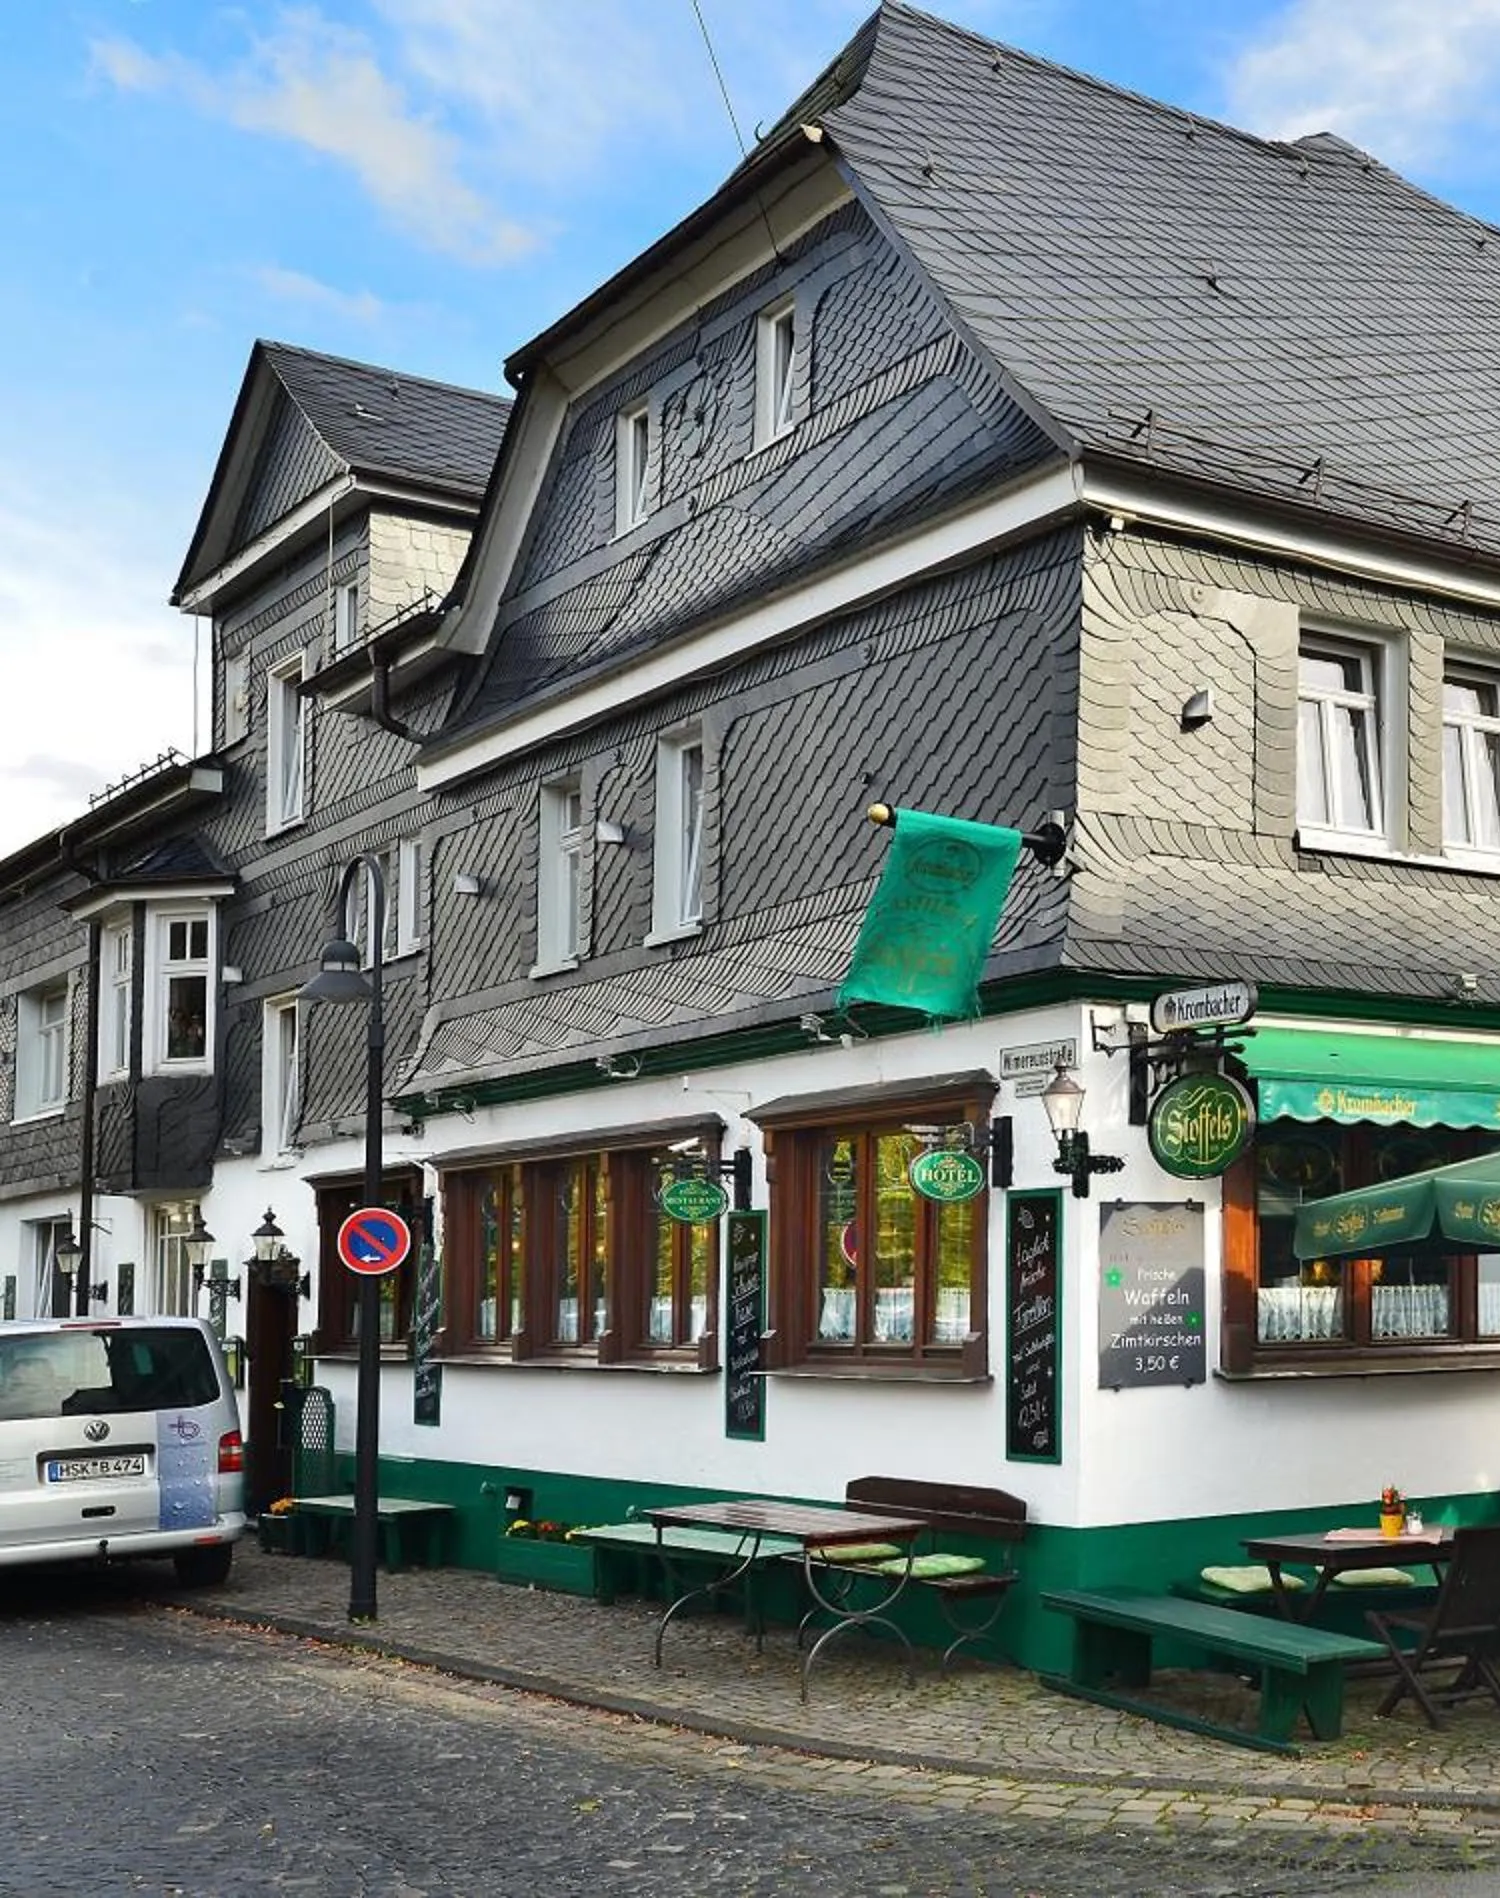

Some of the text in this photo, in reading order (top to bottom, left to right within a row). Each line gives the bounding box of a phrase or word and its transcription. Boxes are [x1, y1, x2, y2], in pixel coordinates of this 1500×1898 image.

[1177, 990, 1241, 1022] Krombacher
[1338, 1088, 1415, 1116] Krombacher
[1165, 1102, 1233, 1160] Stoffels
[921, 1168, 977, 1183] HOTEL
[1124, 1287, 1190, 1306] Waffeln
[1129, 1313, 1183, 1325] mit heißen
[1111, 1332, 1201, 1349] Zimtkirschen
[1135, 1355, 1181, 1374] 3,50 €
[60, 1458, 142, 1477] HSK B 474
